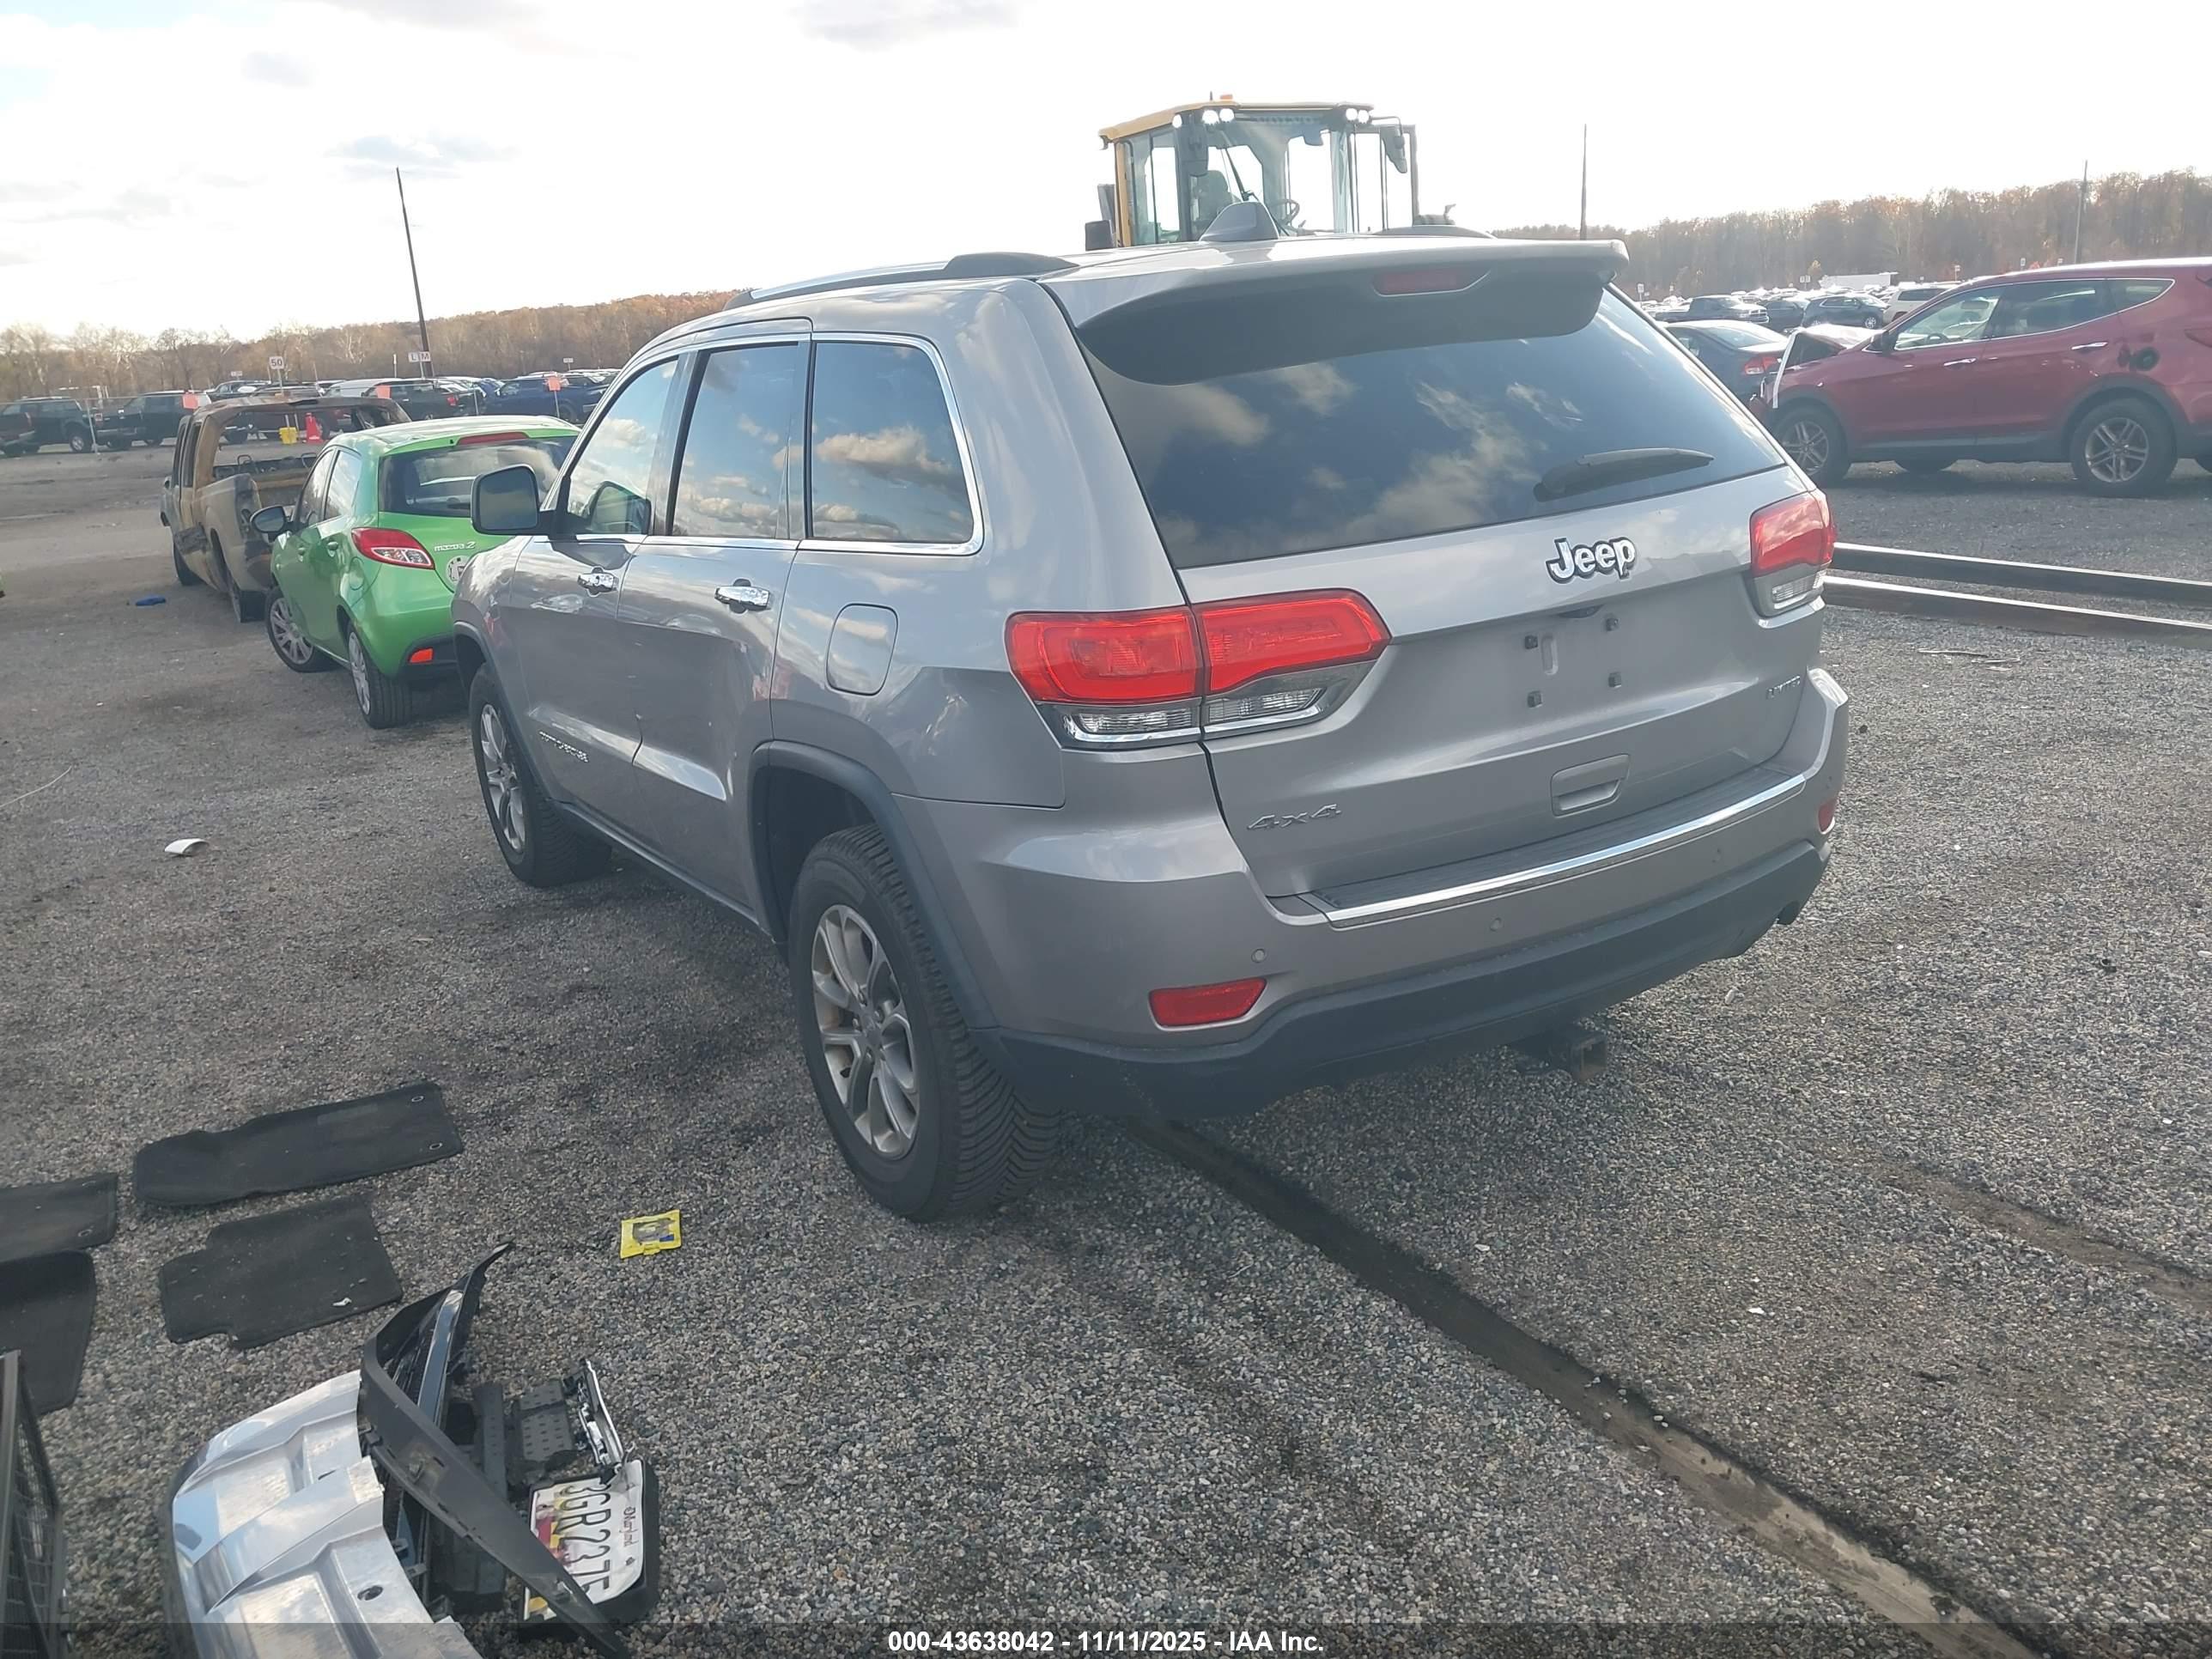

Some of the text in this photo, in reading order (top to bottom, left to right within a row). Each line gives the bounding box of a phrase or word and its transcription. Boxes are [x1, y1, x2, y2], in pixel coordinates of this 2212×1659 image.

[270, 358, 283, 367] 50
[1545, 536, 1636, 584] Jeep
[619, 1506, 639, 1547] Maryland
